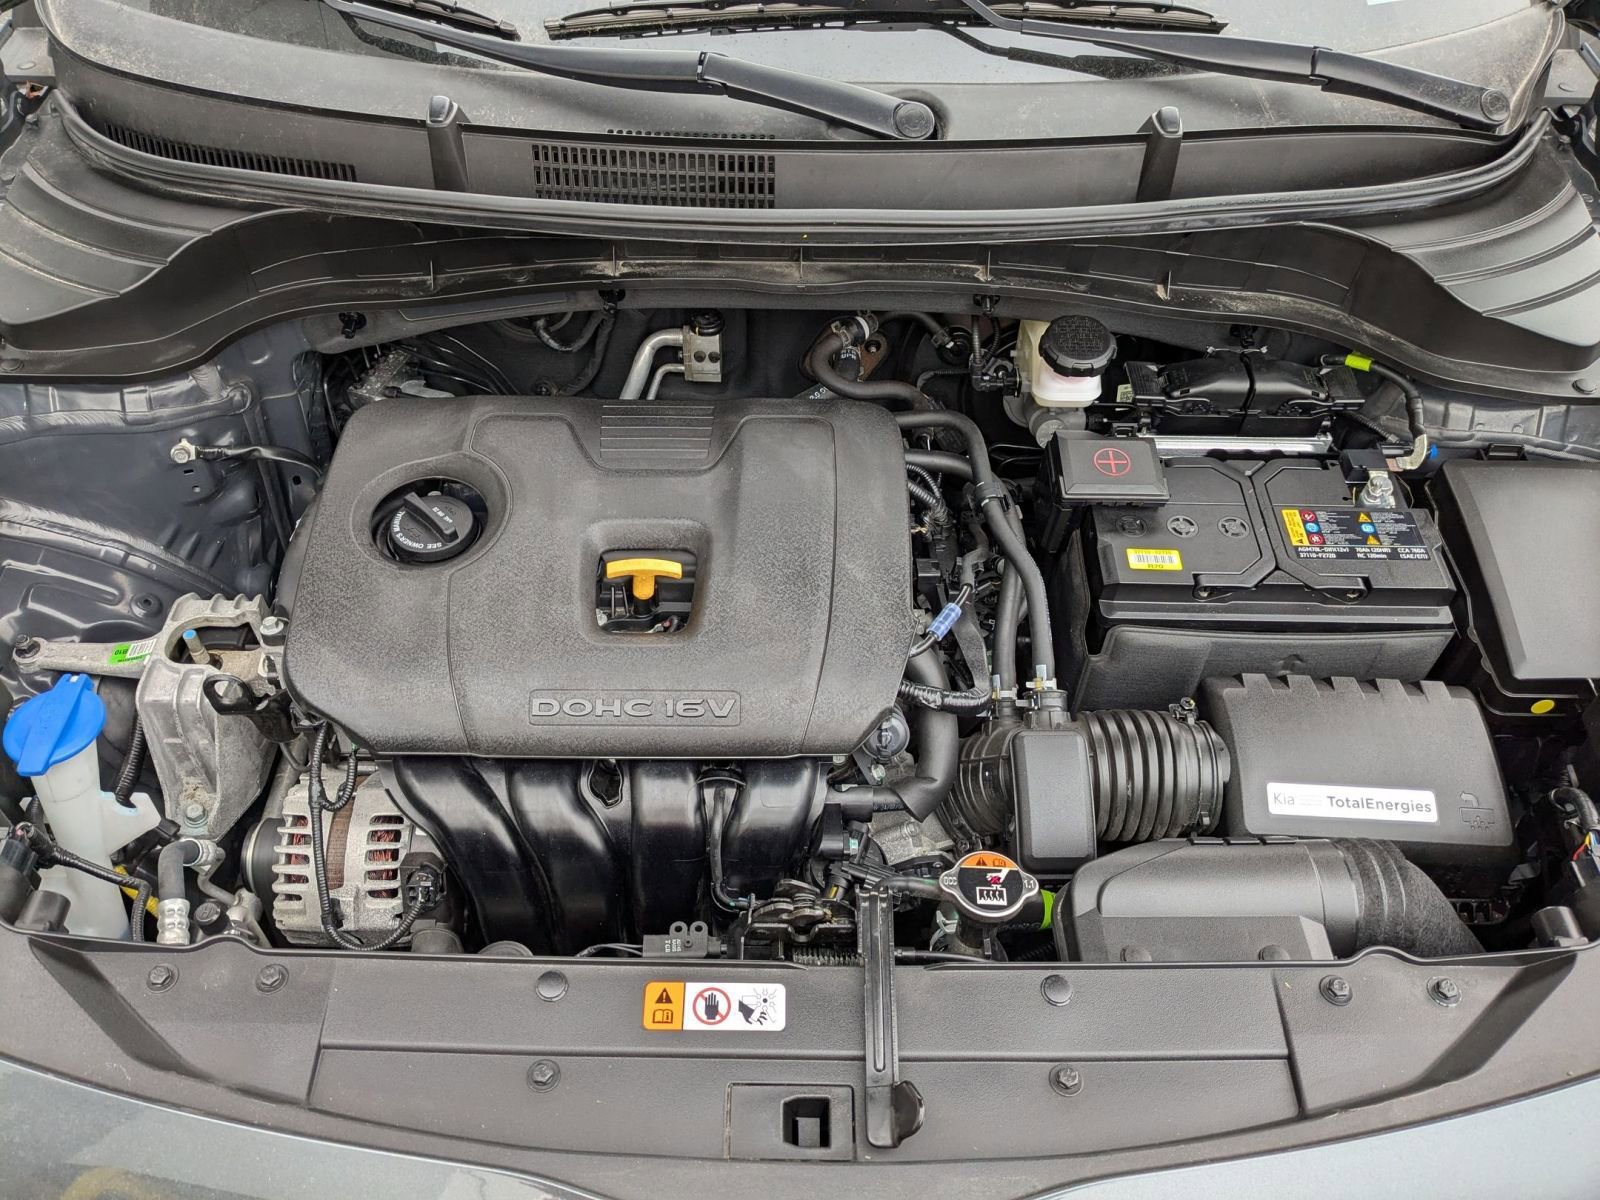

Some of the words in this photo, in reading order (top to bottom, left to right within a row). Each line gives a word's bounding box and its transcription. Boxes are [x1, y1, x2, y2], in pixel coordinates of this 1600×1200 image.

[392, 511, 406, 532] MANUAL
[395, 532, 424, 549] OWNER'S
[531, 698, 654, 718] DOHC
[664, 699, 737, 719] 16V
[1273, 792, 1296, 806] Kia
[1326, 795, 1432, 814] TotalEnergies
[1024, 880, 1034, 889] 1.1
